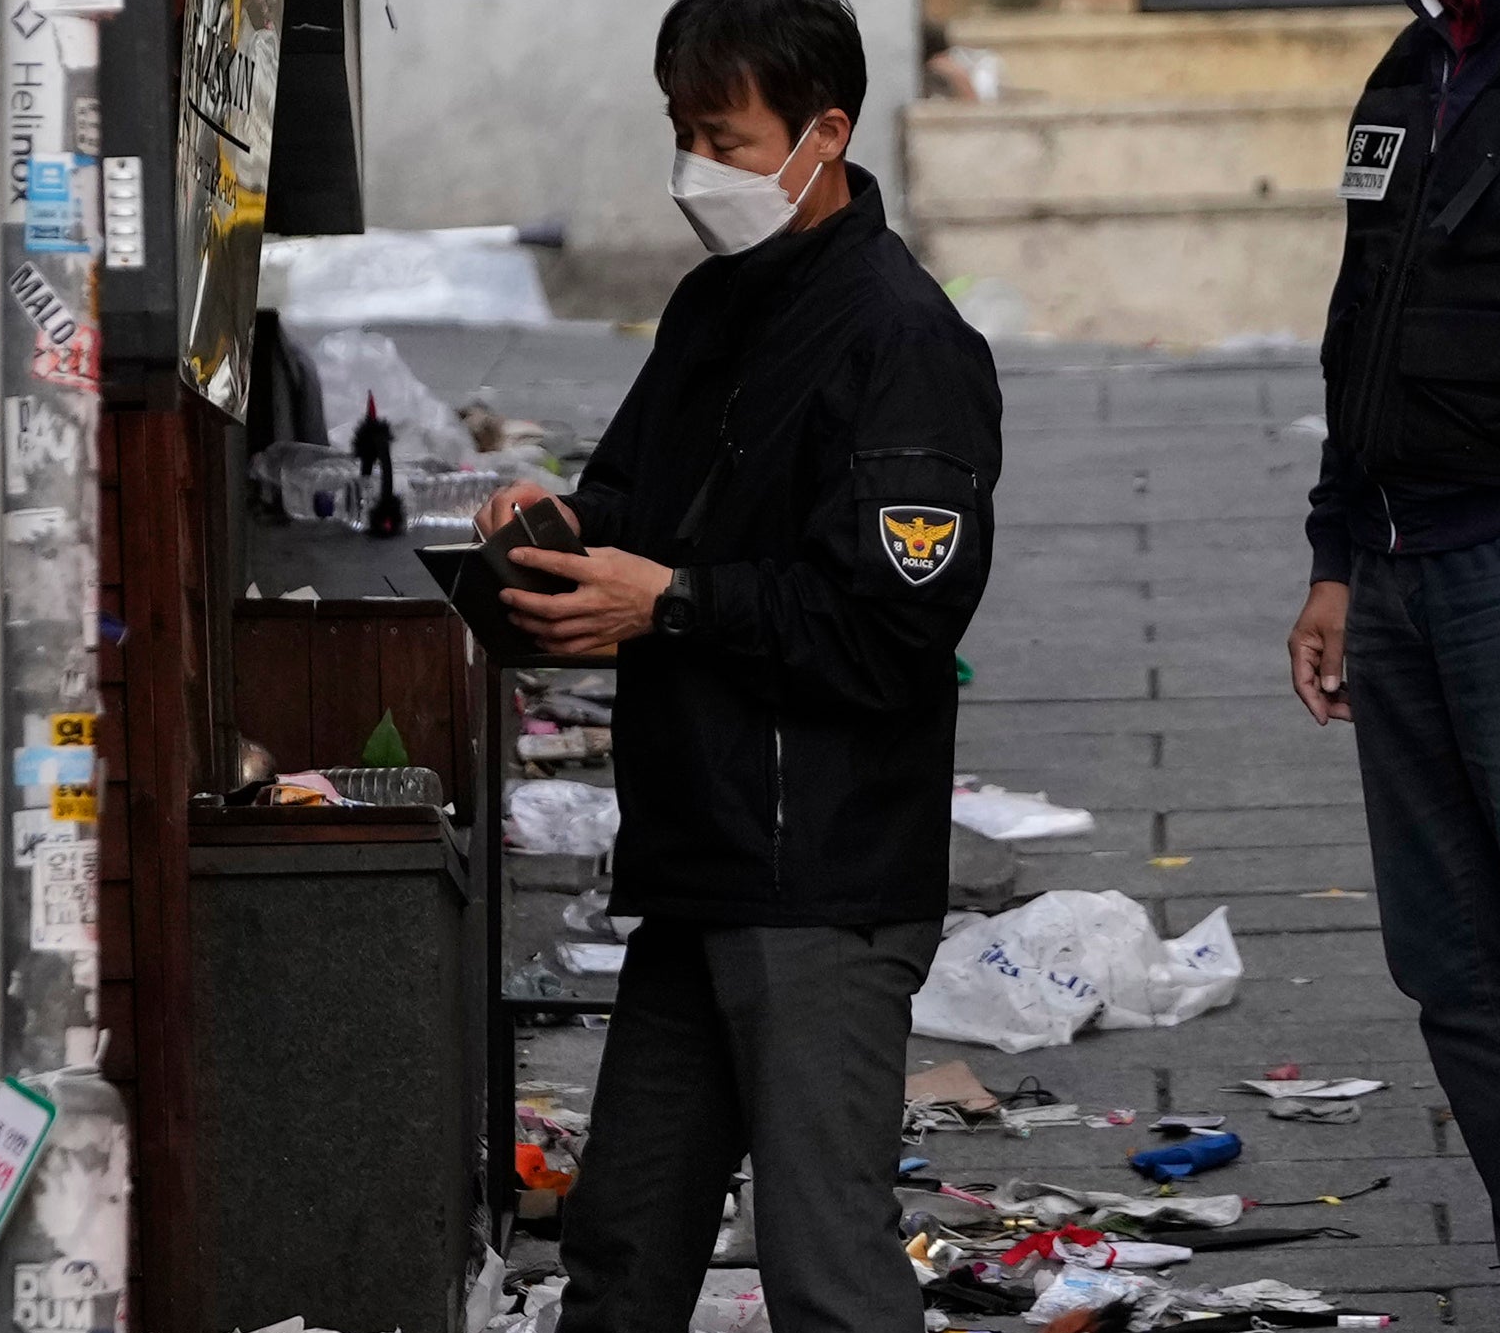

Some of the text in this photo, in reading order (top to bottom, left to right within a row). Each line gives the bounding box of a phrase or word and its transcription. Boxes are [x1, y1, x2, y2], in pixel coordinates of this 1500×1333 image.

[11, 62, 44, 205] Helinox
[1351, 134, 1396, 165] 형사
[10, 265, 77, 345] MALO
[902, 557, 934, 569] POLICE
